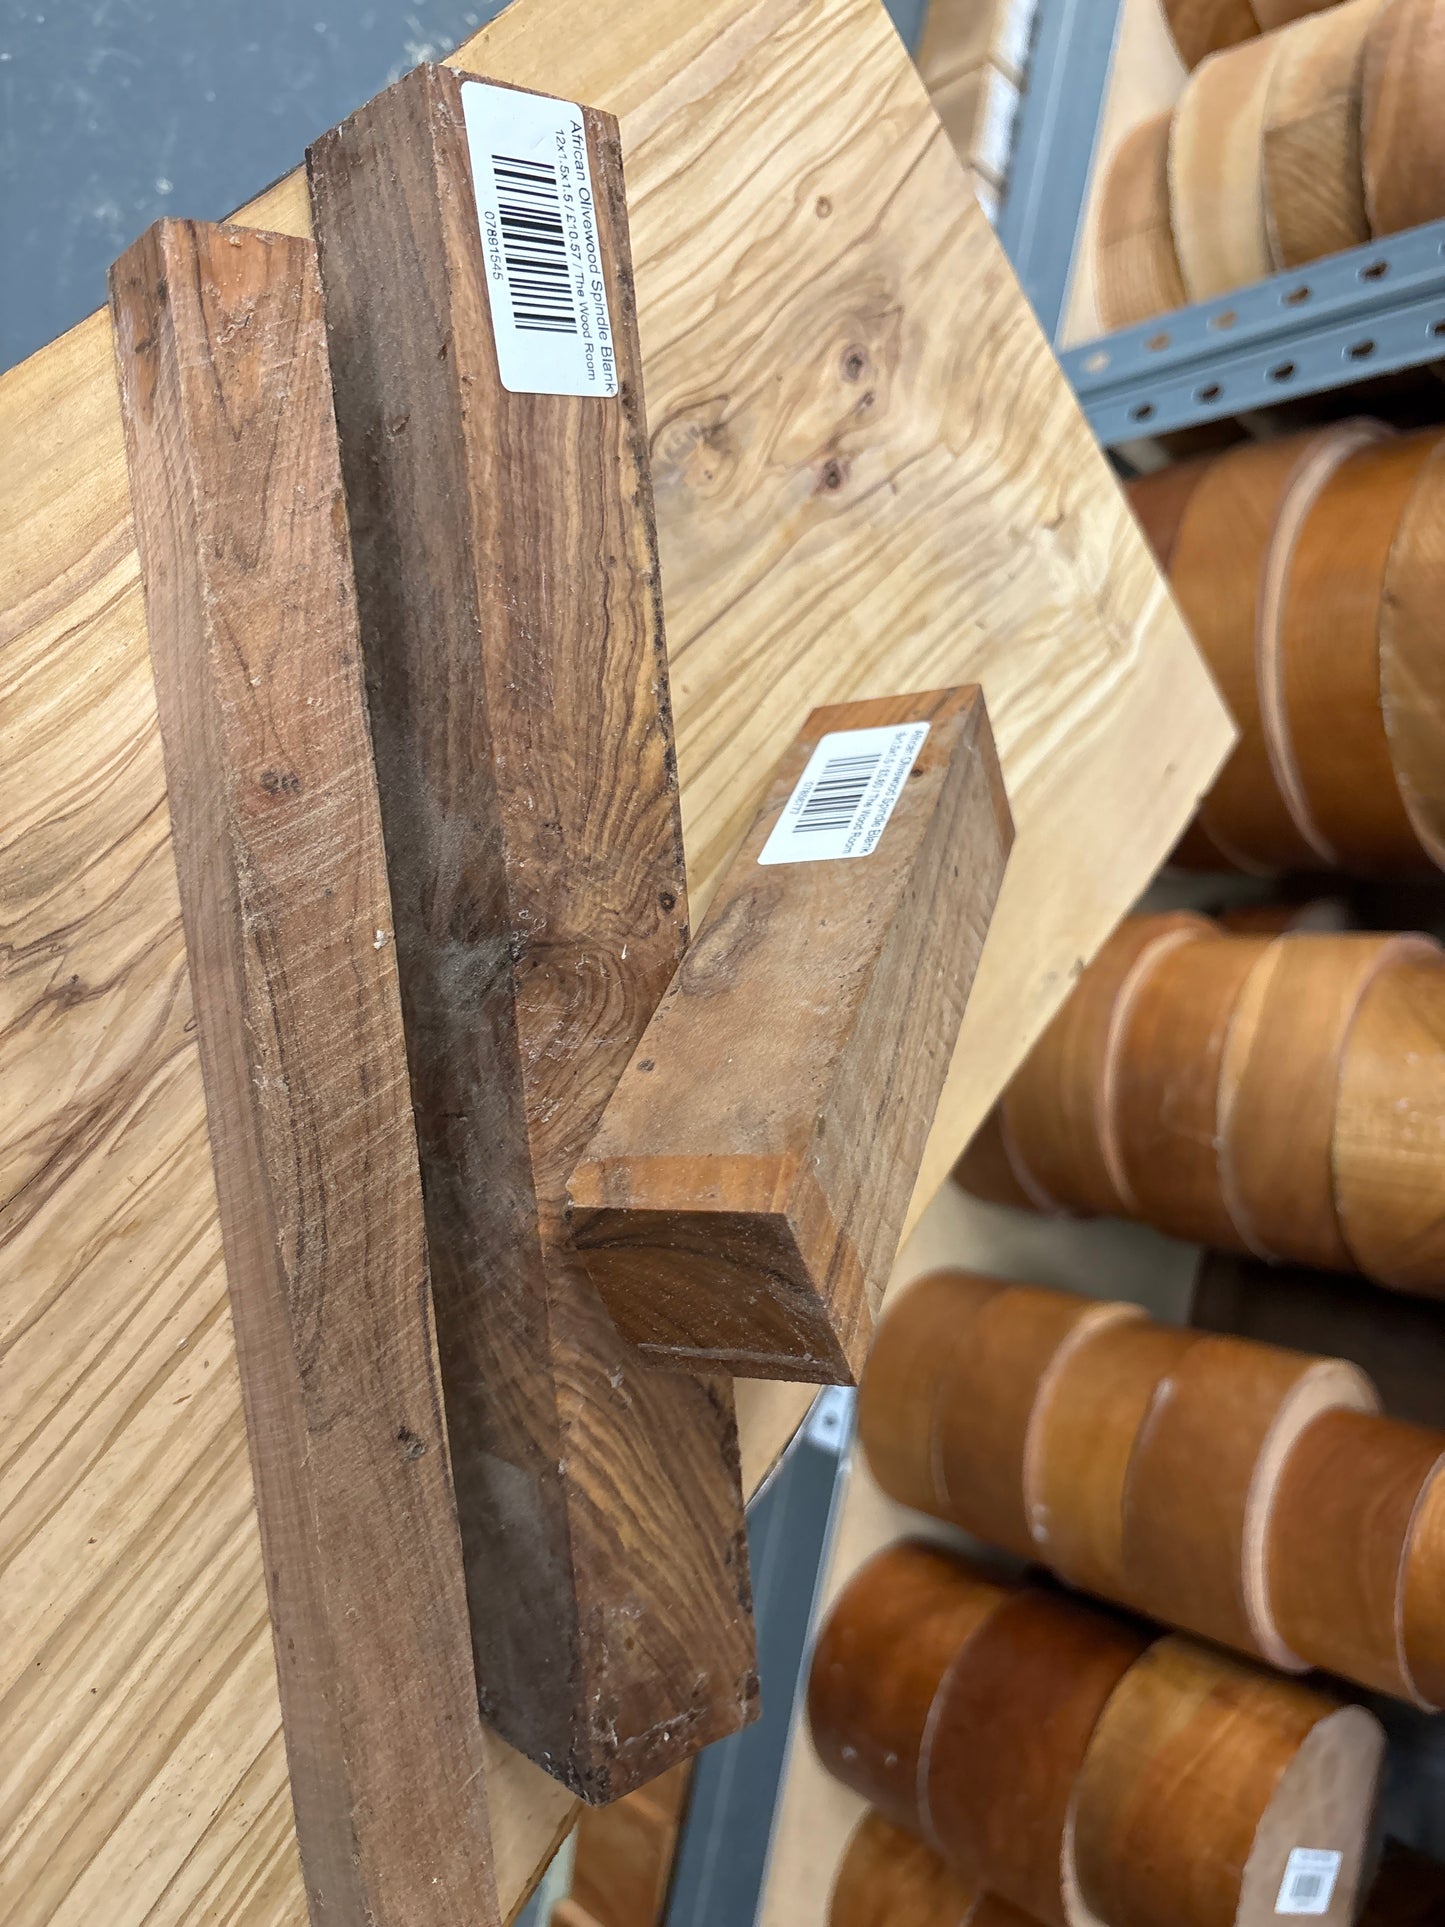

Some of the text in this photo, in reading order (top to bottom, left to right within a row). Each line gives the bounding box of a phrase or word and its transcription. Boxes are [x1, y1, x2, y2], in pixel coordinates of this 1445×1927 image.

[555, 129, 573, 202] 12x1.5x1.5
[484, 211, 504, 281] 07891545
[566, 213, 582, 260] £10.57
[570, 120, 616, 393] African Olivewood Spindle Blank
[575, 272, 585, 297] The
[579, 301, 593, 338] Wood
[584, 342, 596, 381] Room
[863, 793, 880, 808] The
[871, 797, 895, 828] Spindle
[852, 808, 872, 831] Wood
[842, 831, 862, 854] Room
[859, 829, 881, 854] Blank
